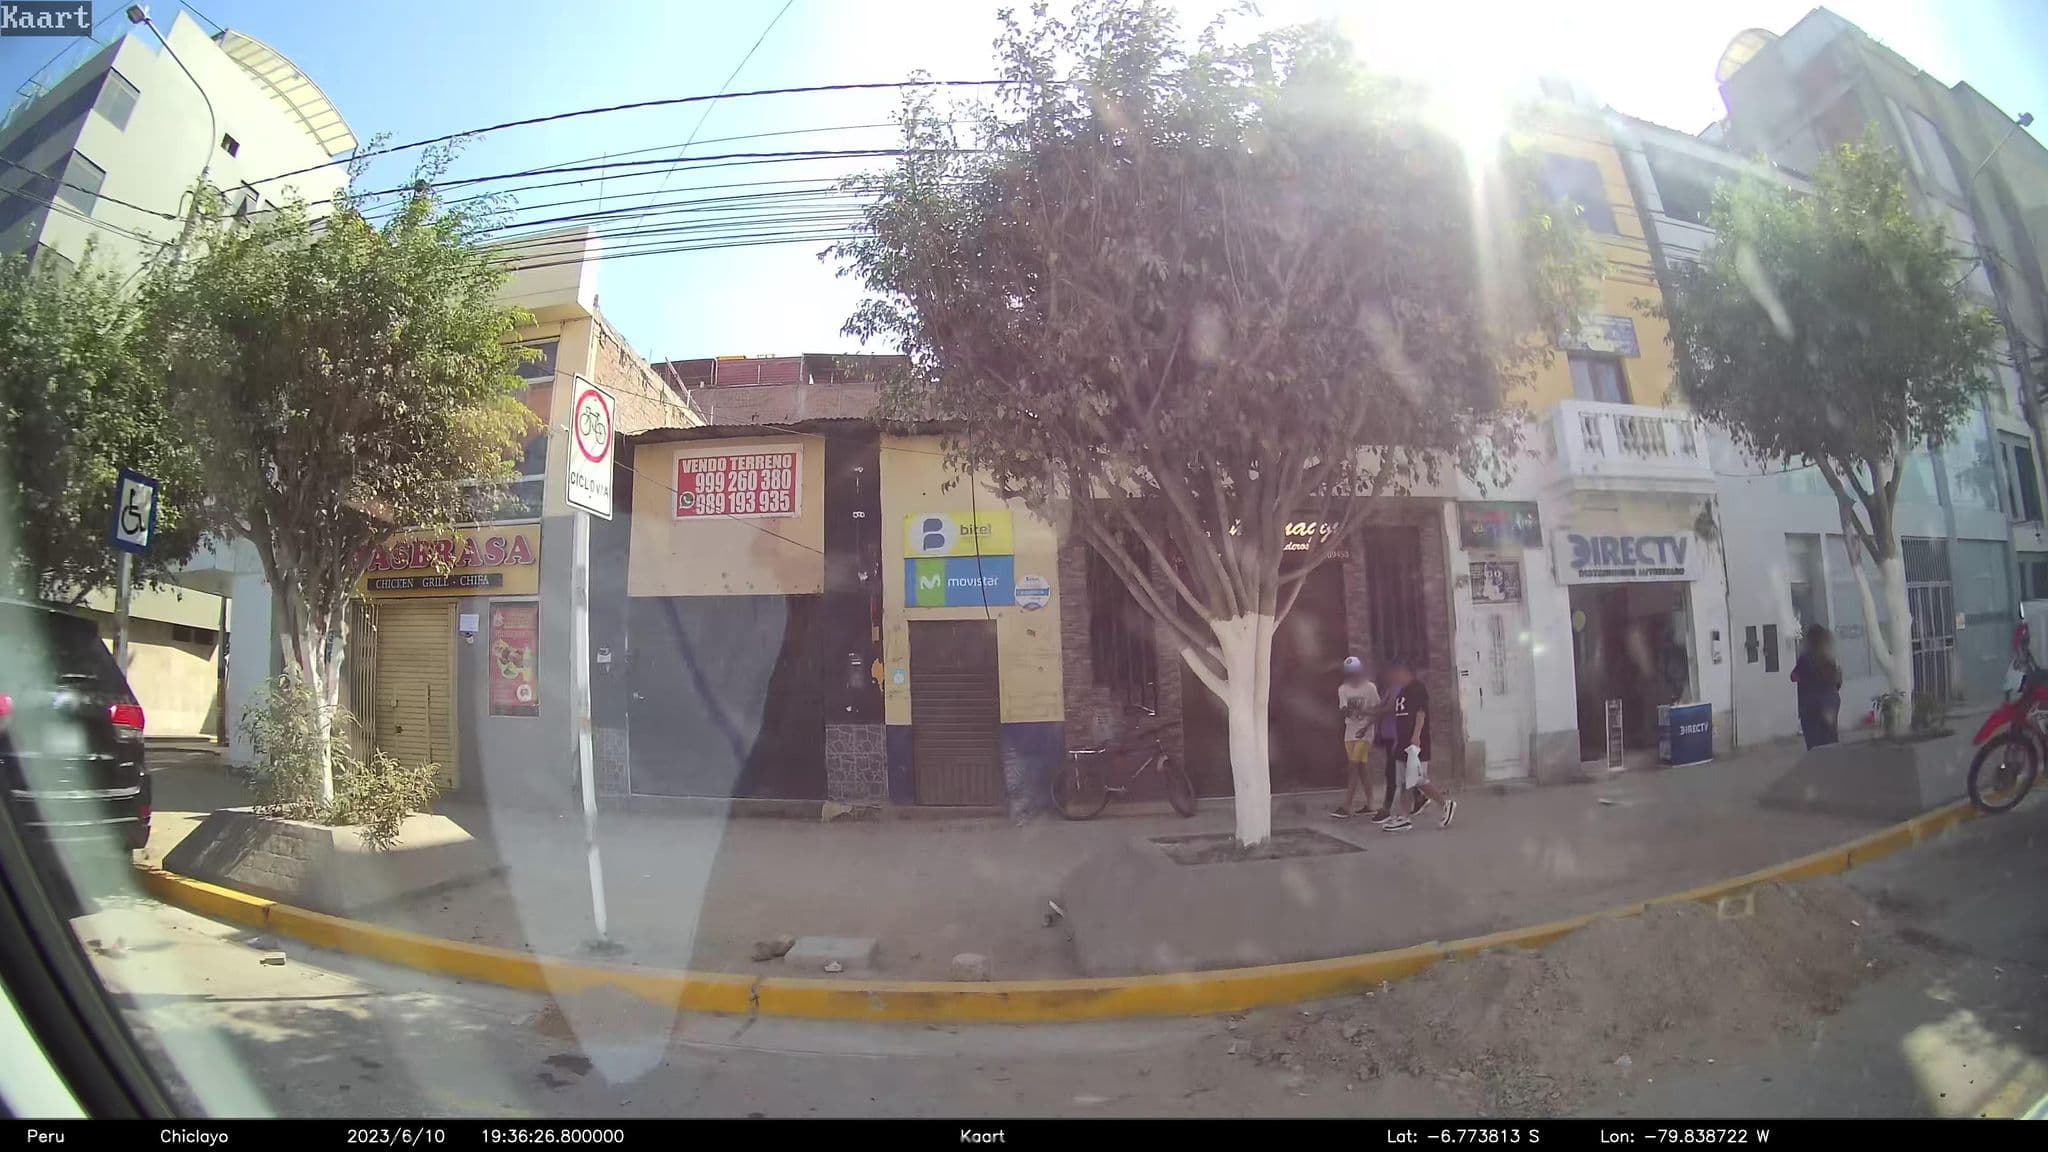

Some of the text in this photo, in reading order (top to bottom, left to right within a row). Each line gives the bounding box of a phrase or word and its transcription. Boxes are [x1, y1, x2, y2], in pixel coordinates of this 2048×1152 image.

[682, 454, 792, 474] VENDO TERRENO
[695, 468, 792, 494] 999 260 380
[695, 490, 790, 515] 989 193 935
[959, 524, 992, 537] bitel
[1567, 534, 1687, 569] DIRECTV
[375, 578, 414, 590] CHICKEN
[422, 576, 450, 588] GRILL
[459, 575, 490, 587] CHIFA
[947, 575, 1000, 588] movistar
[1679, 721, 1710, 736] DIRECTV
